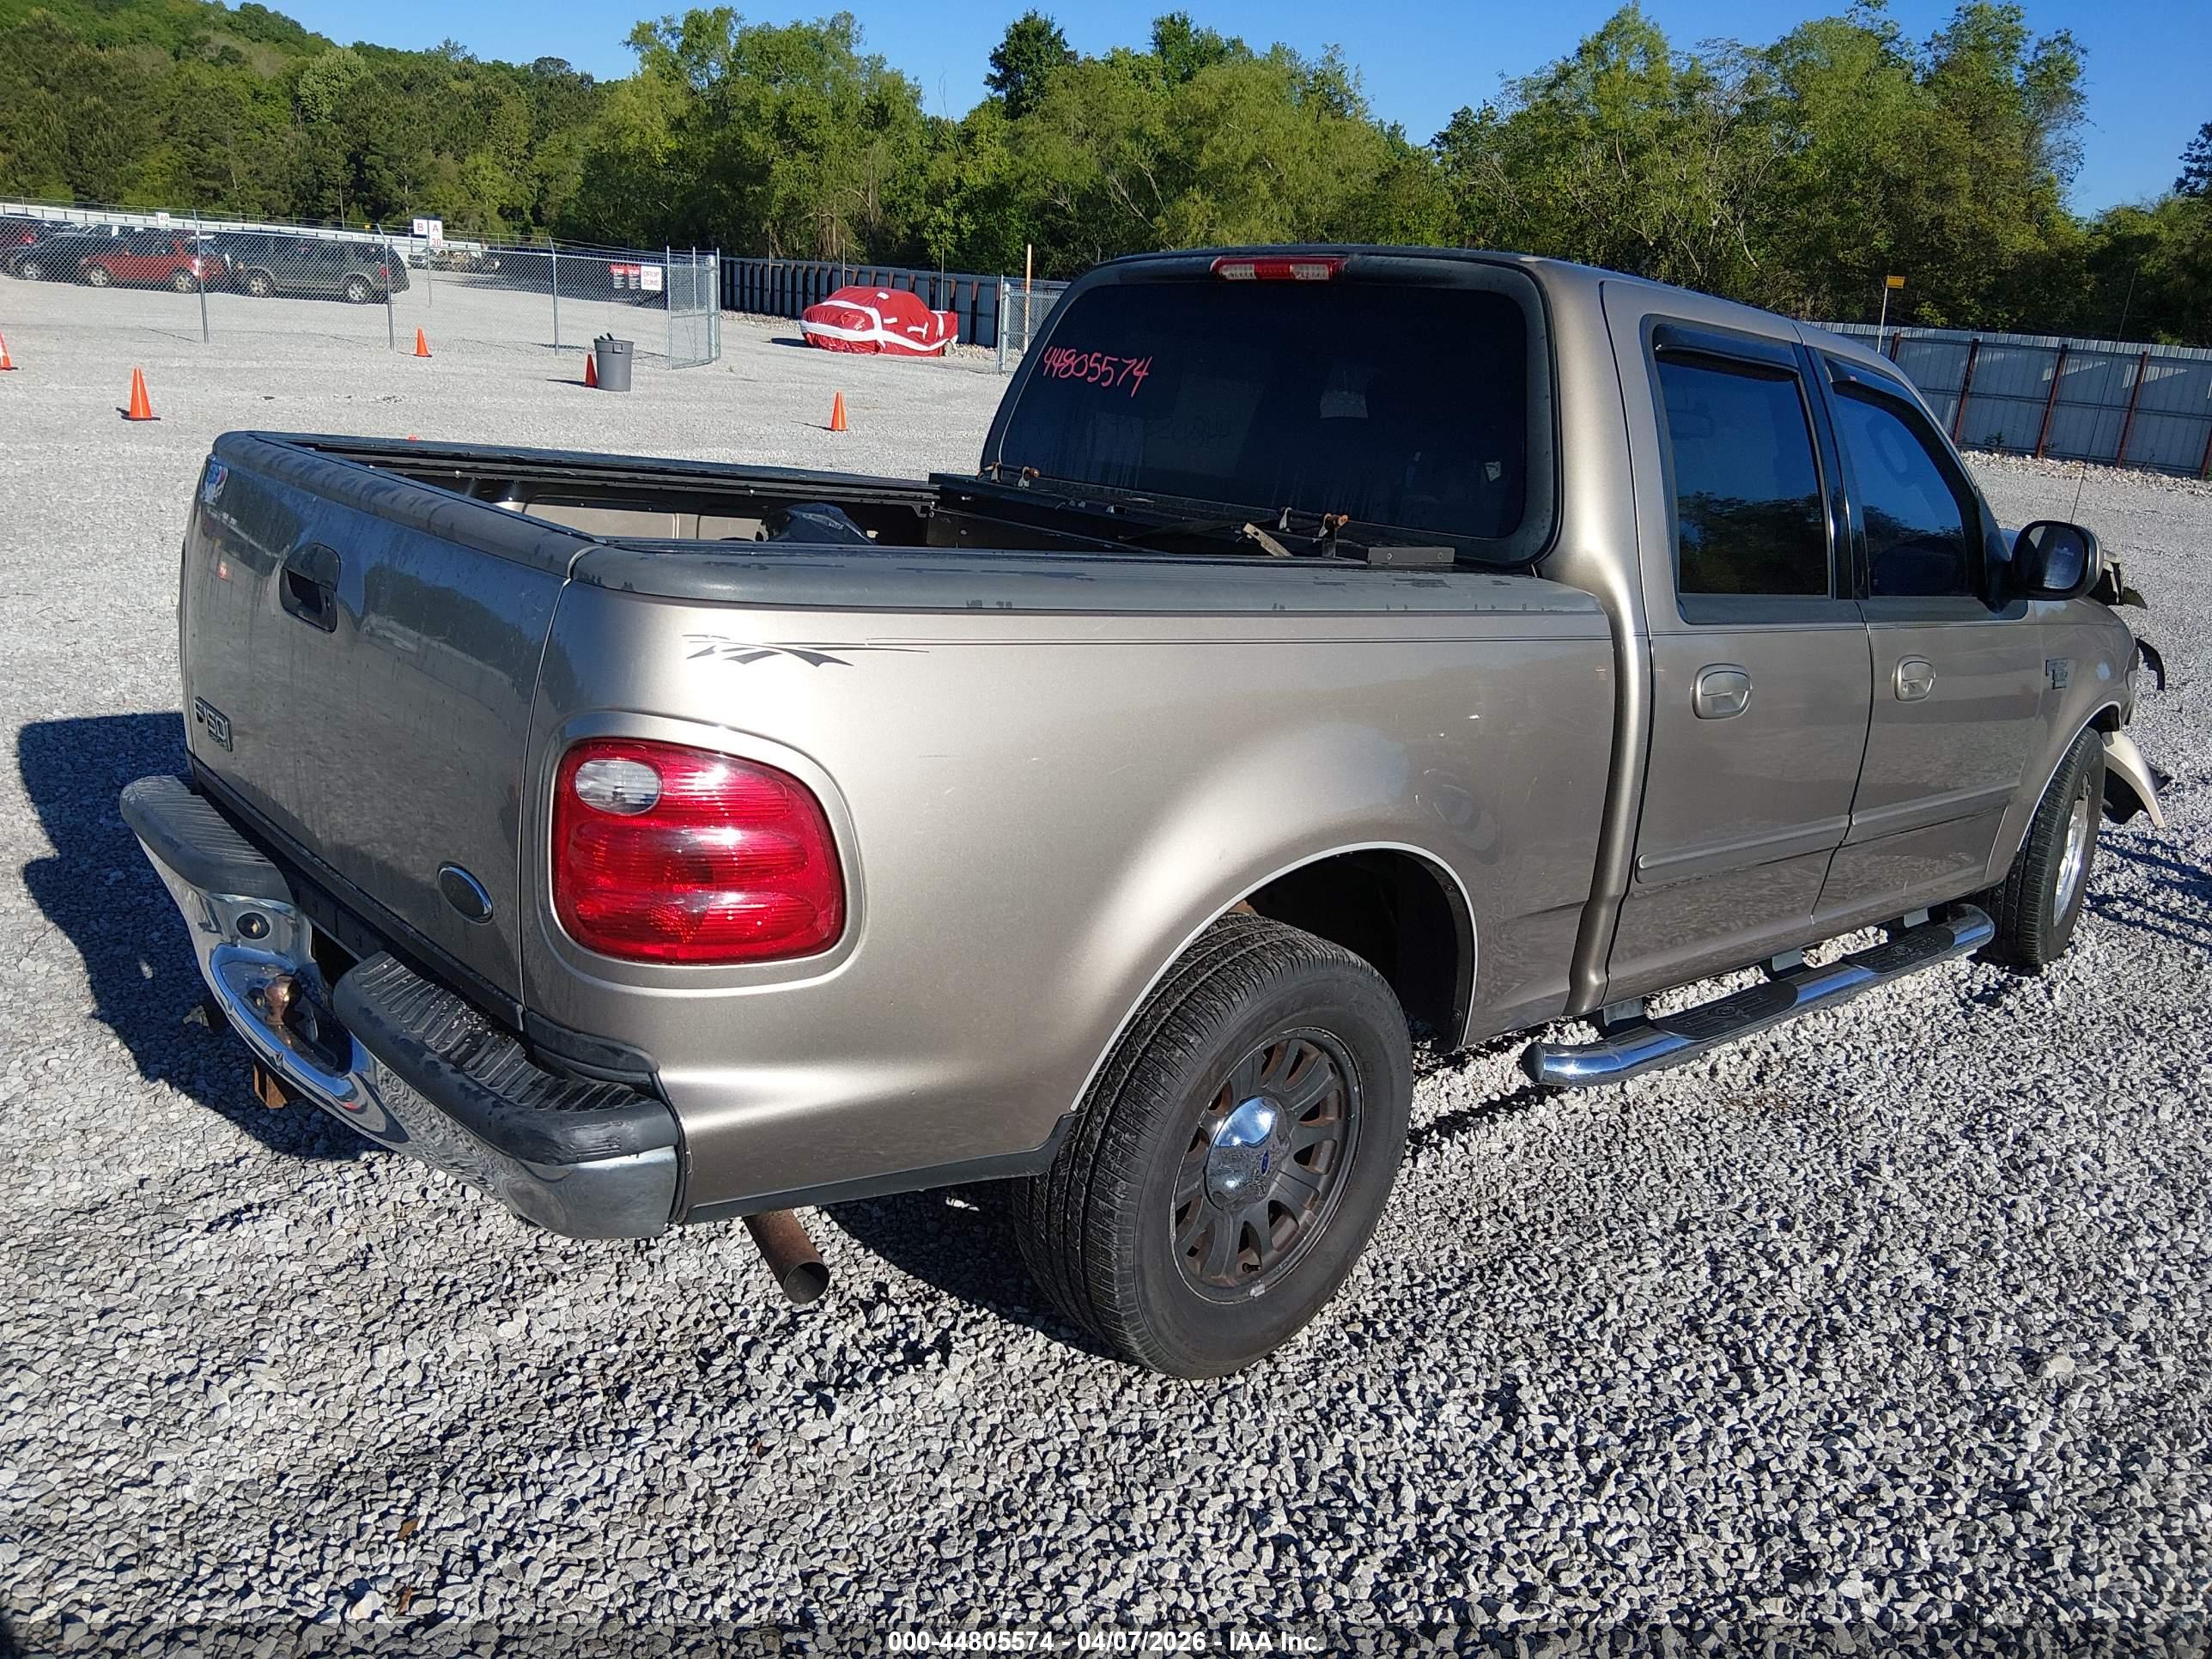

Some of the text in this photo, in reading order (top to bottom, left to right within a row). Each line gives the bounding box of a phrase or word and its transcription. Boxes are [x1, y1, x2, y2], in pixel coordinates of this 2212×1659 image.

[417, 222, 424, 232] B
[432, 224, 440, 233] A
[432, 238, 441, 247] 30
[1042, 345, 1154, 398] 44805574
